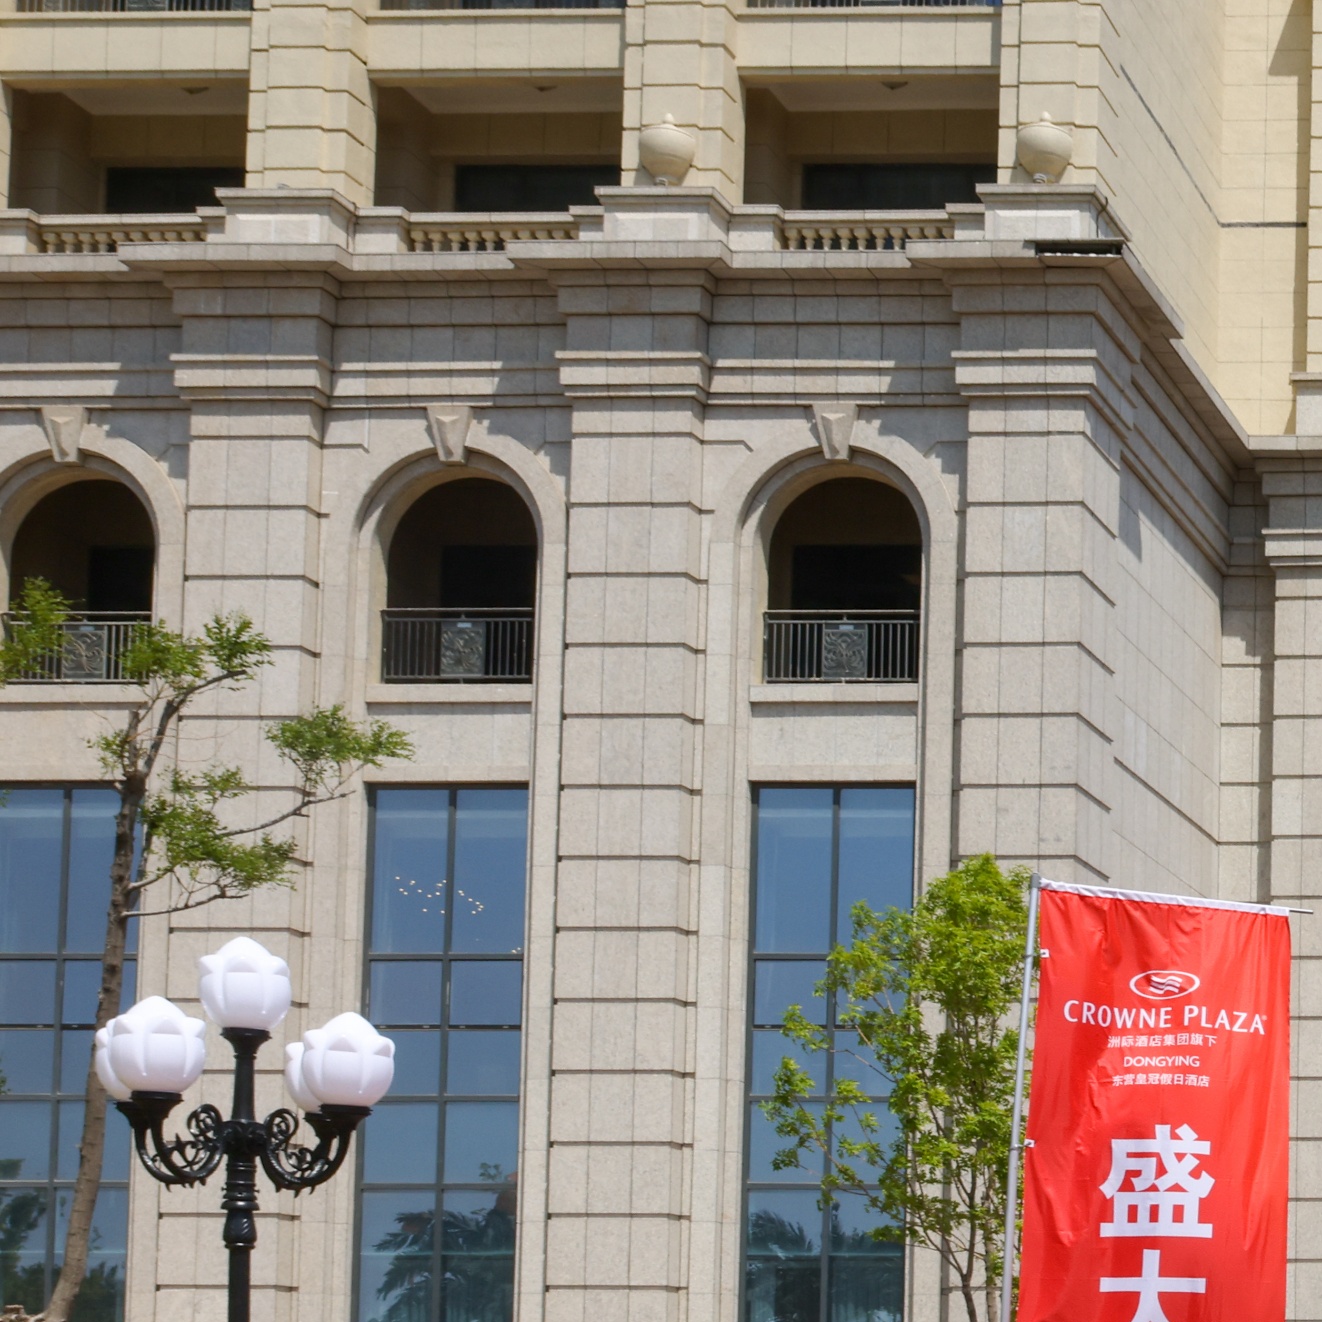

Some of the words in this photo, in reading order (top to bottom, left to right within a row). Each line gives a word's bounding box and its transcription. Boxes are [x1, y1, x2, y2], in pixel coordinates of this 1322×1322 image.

[1063, 1000, 1172, 1029] CROWNE
[1183, 1005, 1266, 1035] PLAZA
[1107, 1033, 1218, 1048] 洲际酒店集团旗下
[1124, 1056, 1200, 1067] DONGYING
[1112, 1073, 1210, 1087] 东营皇冠假日酒店
